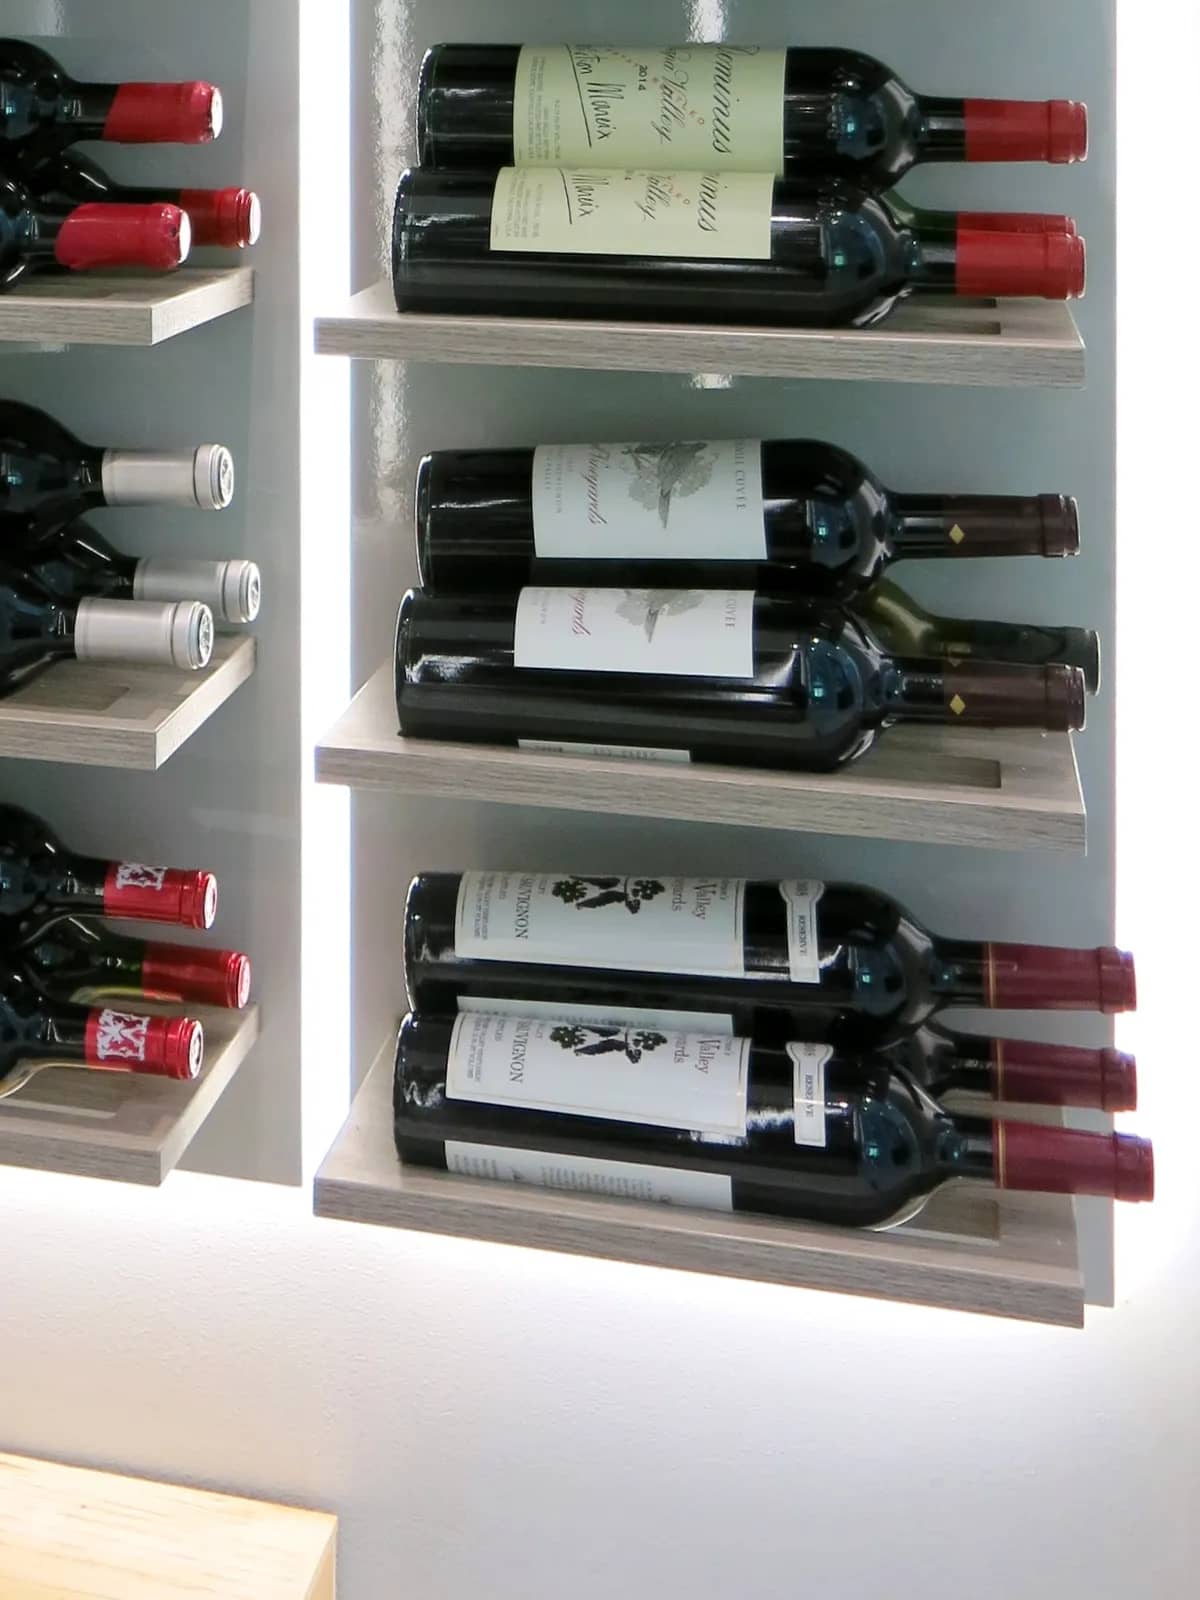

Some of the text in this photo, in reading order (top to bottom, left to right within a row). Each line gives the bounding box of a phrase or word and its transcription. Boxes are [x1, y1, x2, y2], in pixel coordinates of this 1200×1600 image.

[637, 65, 649, 92] 2014
[650, 67, 689, 144] Valley
[692, 883, 718, 921] Valley
[797, 914, 808, 954] RESERVE
[694, 1038, 722, 1075] Valley
